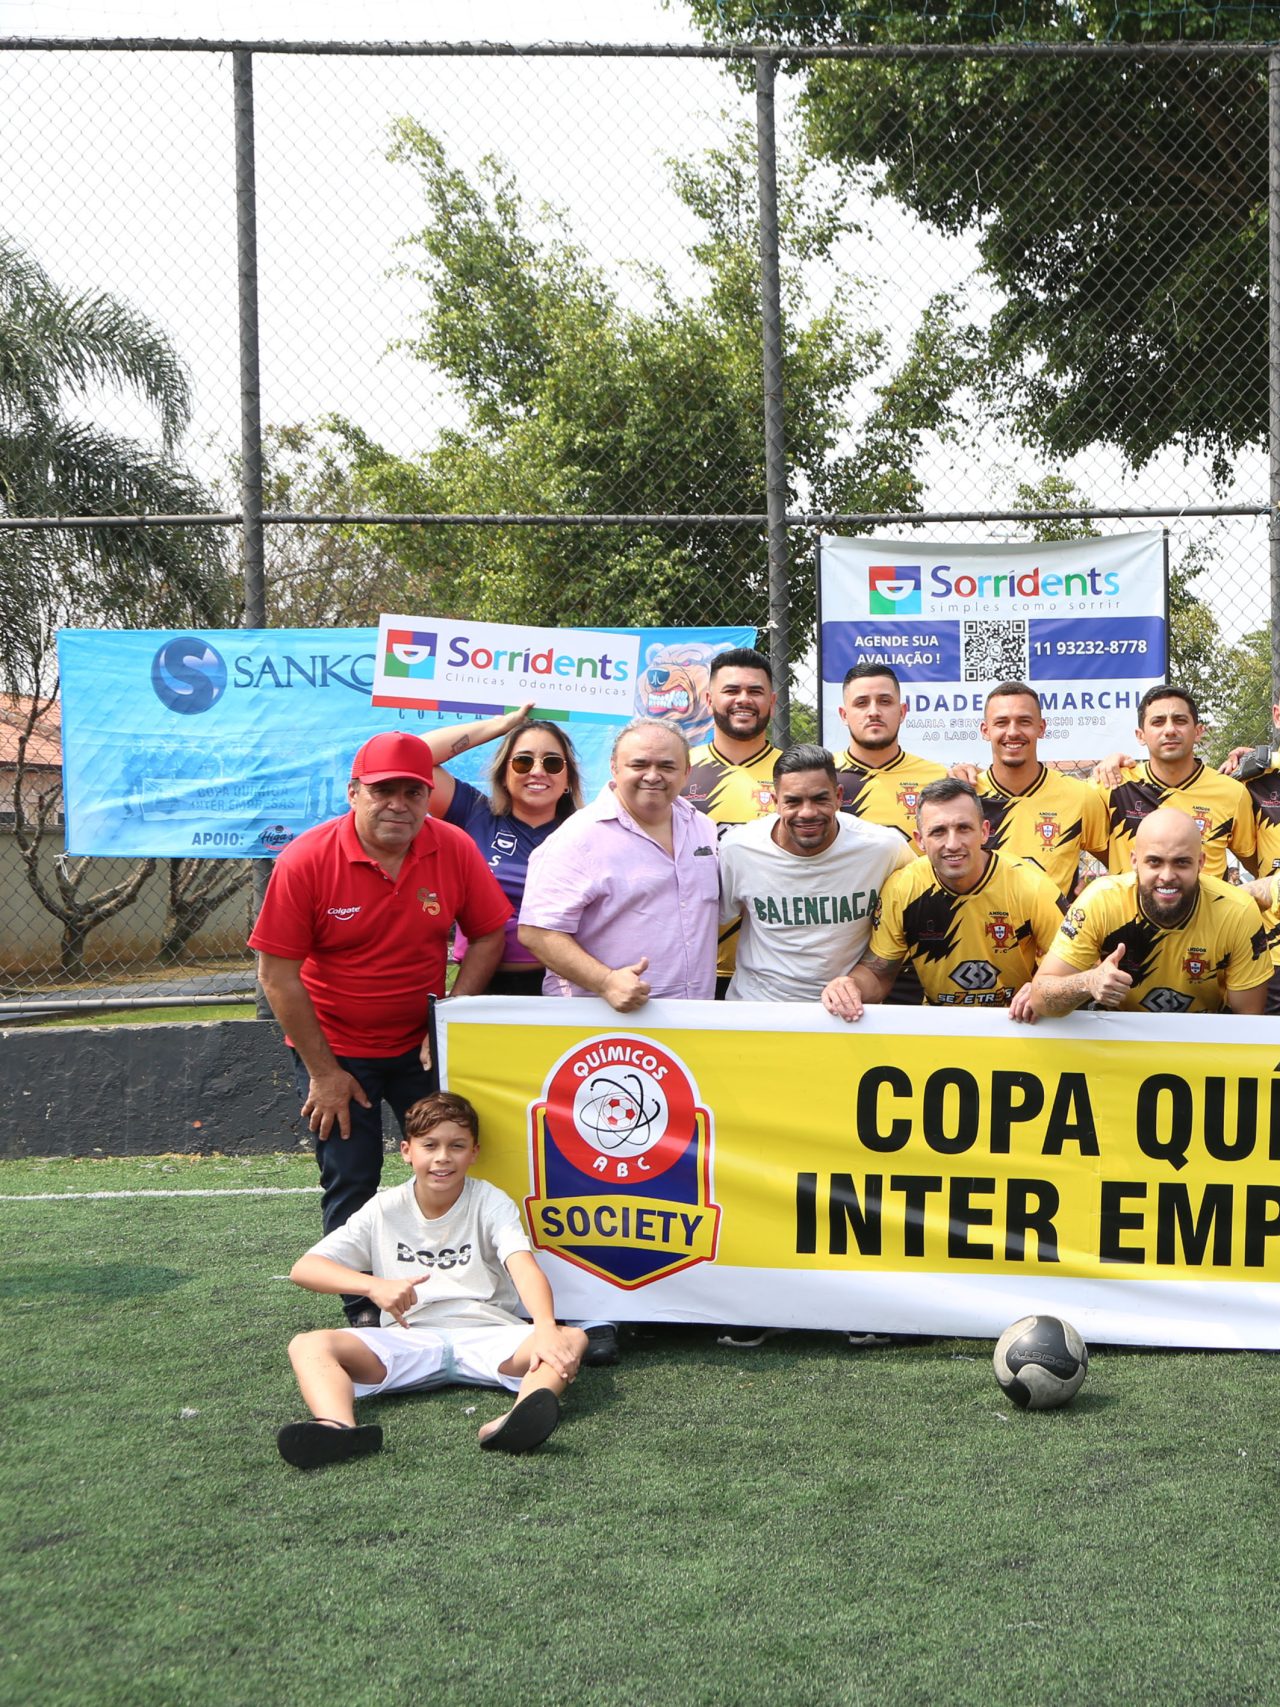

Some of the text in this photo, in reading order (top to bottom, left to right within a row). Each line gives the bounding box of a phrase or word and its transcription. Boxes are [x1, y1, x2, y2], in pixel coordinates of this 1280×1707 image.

[930, 599, 1121, 614] simples como sorrir
[854, 635, 939, 647] AGENDE SUA
[1034, 640, 1148, 656] 11 93232-8778
[857, 650, 933, 666] AVALIAÇÃO
[906, 718, 946, 728] MARIA
[1077, 716, 1106, 726] 1791
[922, 732, 941, 742] AO
[945, 732, 979, 742] LADO
[191, 832, 244, 846] APOIO:
[327, 906, 361, 916] Colgate
[938, 992, 975, 1005] SE7E
[573, 1043, 669, 1081] QUÍMICOS
[855, 1064, 1100, 1159] COPA
[794, 1171, 1061, 1264] INTER
[540, 1205, 704, 1247] SOCIETY
